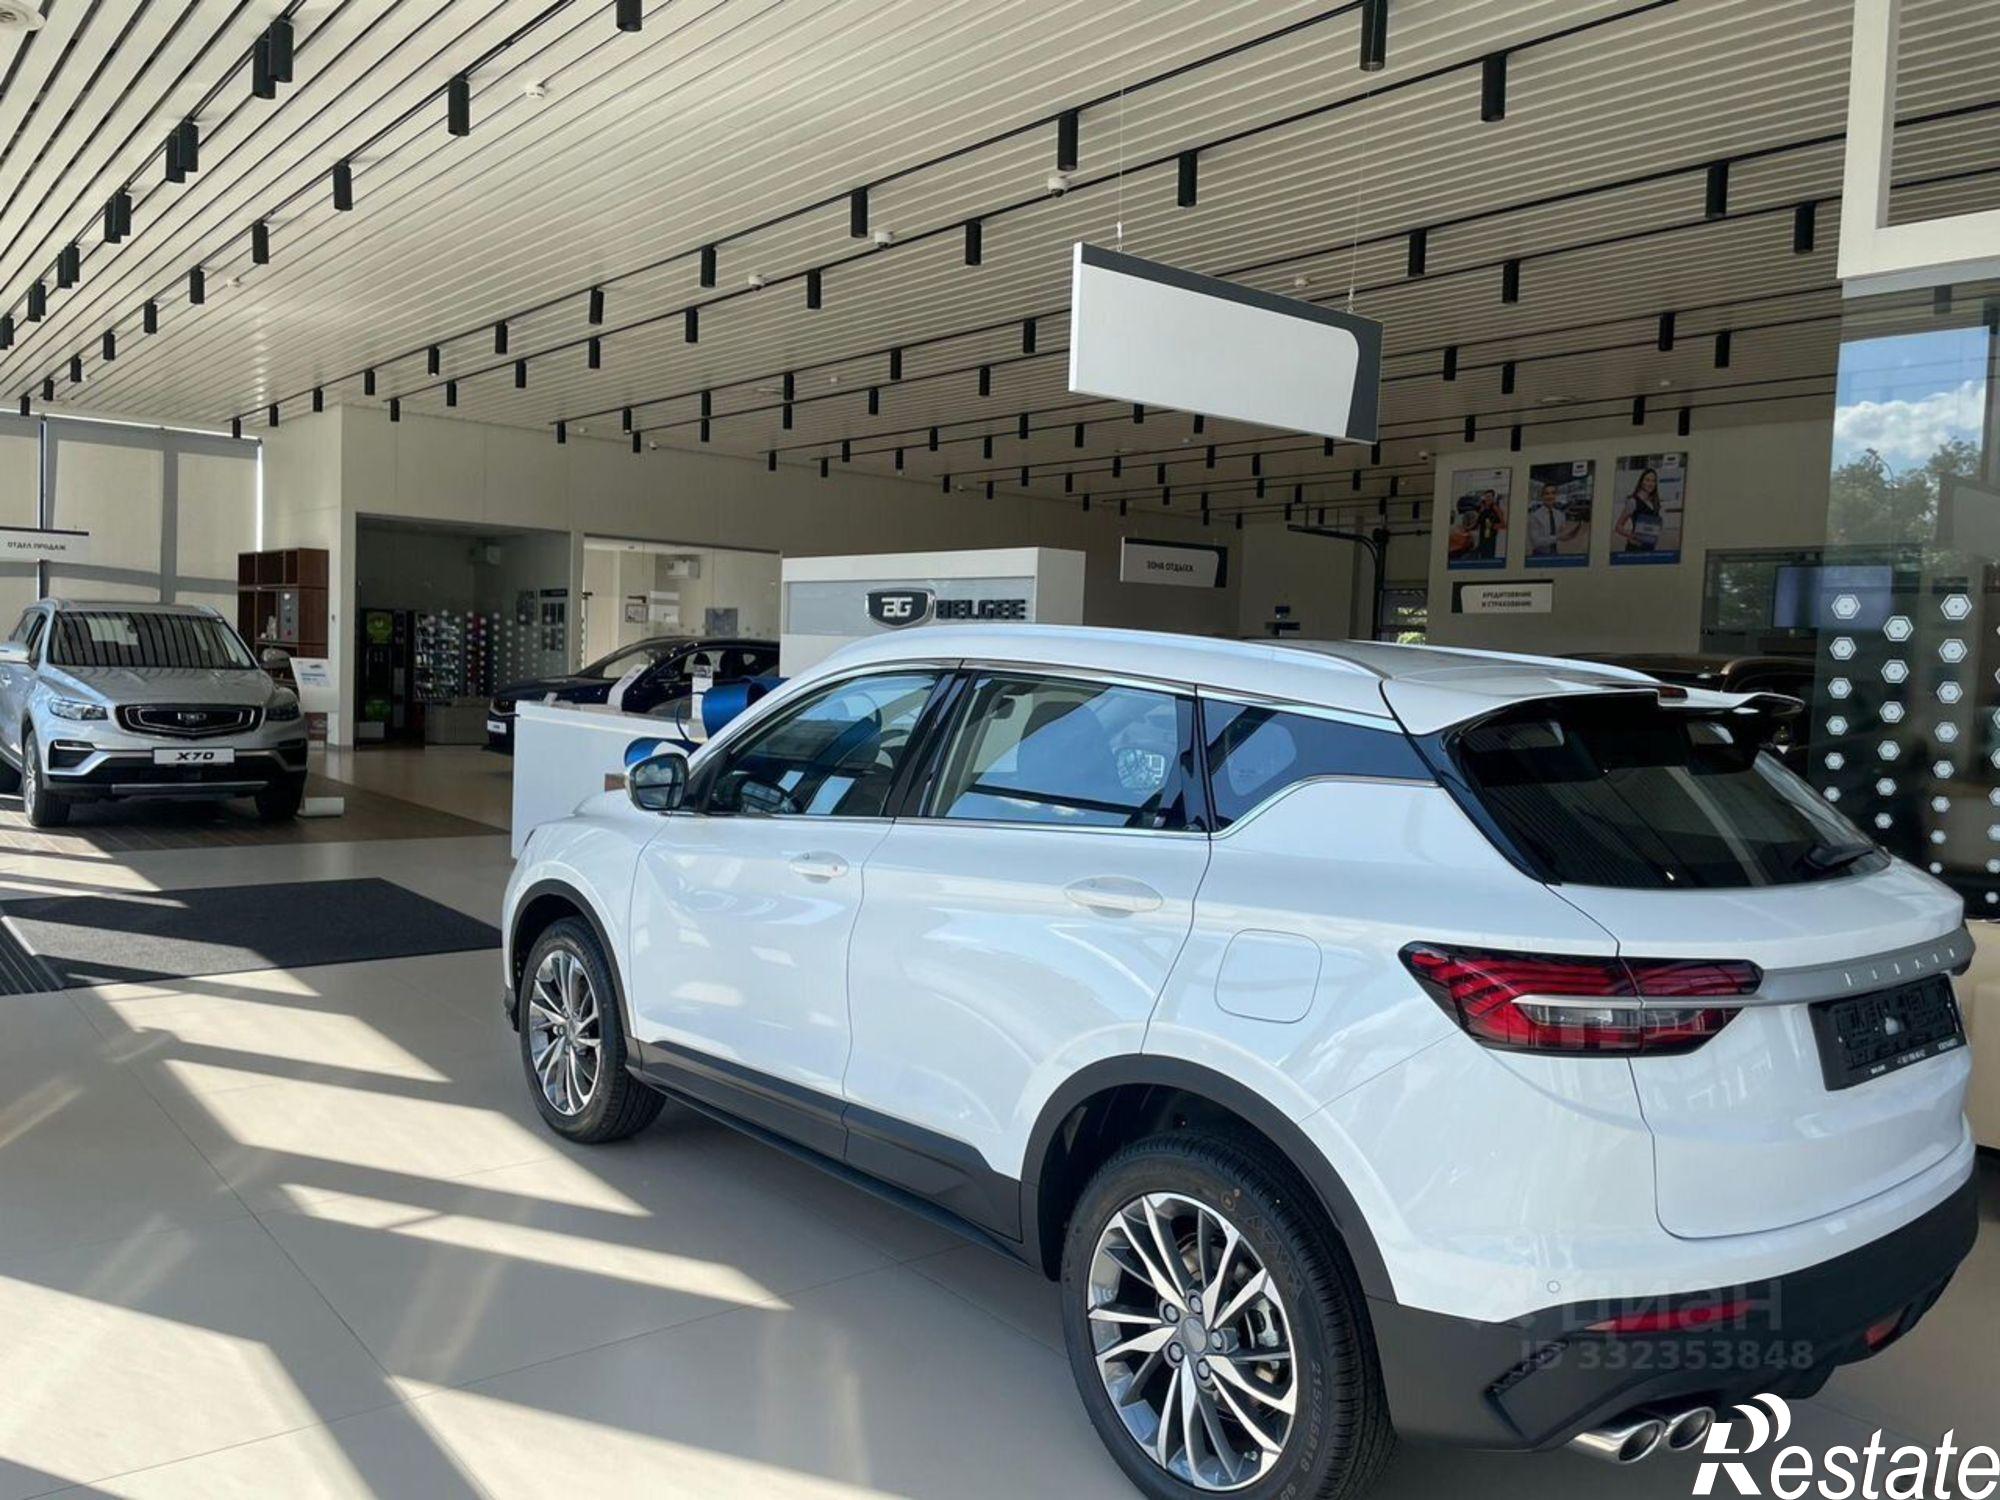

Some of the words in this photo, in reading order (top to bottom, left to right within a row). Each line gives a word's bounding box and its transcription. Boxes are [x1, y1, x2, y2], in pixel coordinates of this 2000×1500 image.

[7, 541, 32, 549] ОТДЕЛ
[33, 543, 67, 551] ПРОДАЖ
[935, 599, 1026, 620] BELGEE
[176, 751, 215, 761] X70
